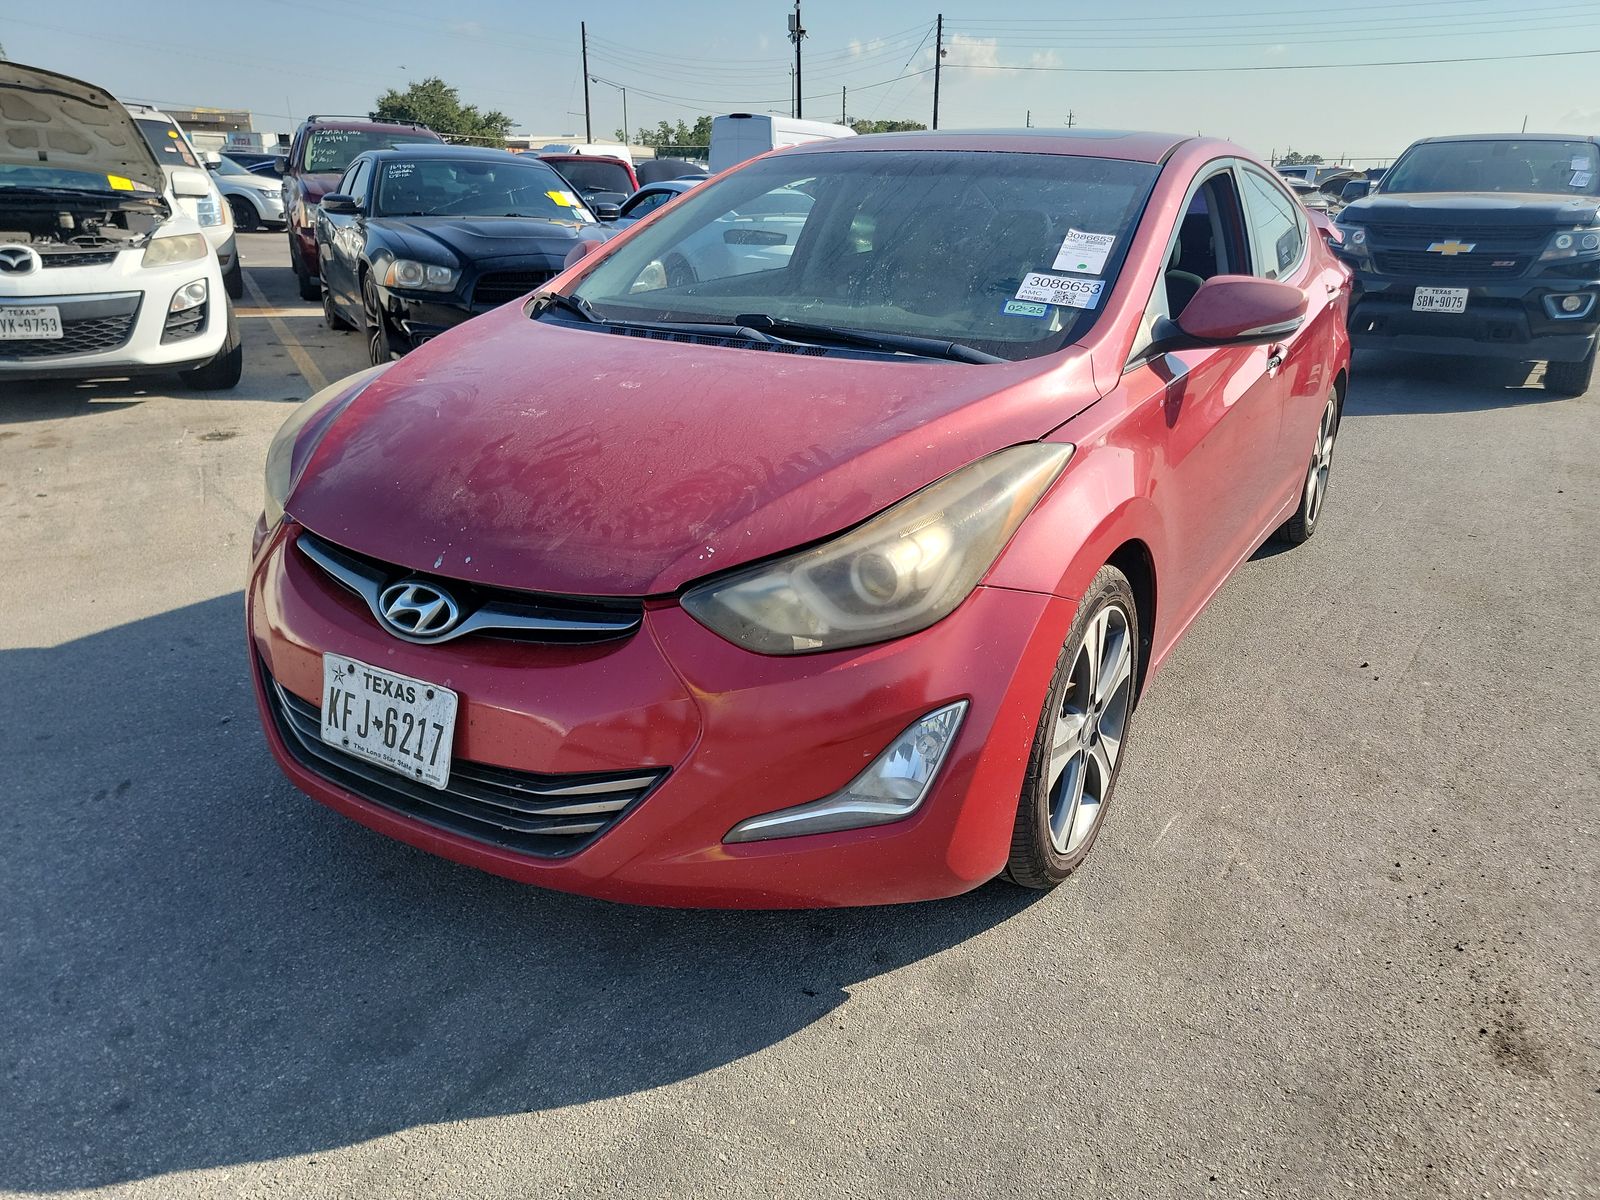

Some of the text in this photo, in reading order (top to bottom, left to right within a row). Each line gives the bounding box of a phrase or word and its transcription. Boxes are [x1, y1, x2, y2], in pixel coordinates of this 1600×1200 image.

[1067, 231, 1113, 242] 3086653
[1029, 276, 1102, 295] 3086653
[363, 672, 416, 704] TEXAS
[353, 742, 365, 751] The
[382, 753, 396, 763] Star
[397, 759, 412, 770] State
